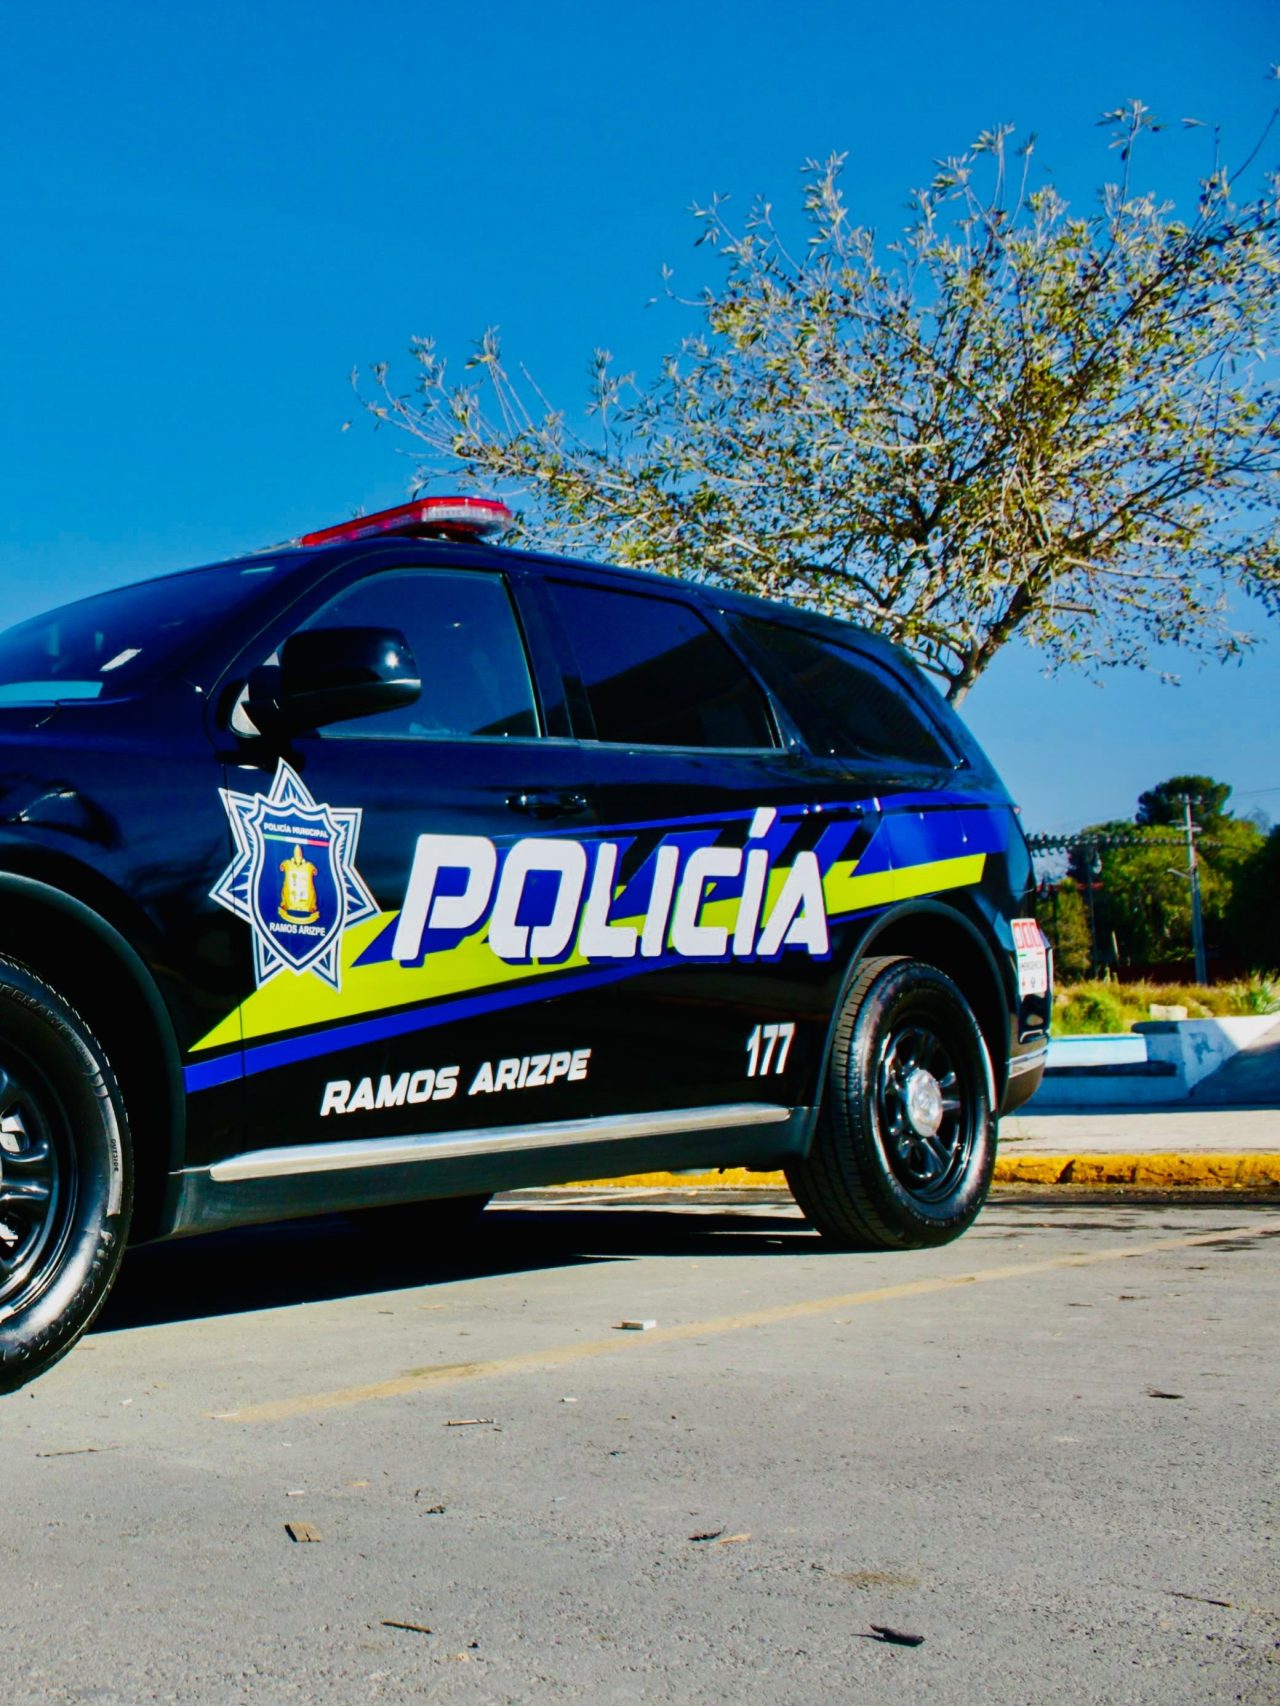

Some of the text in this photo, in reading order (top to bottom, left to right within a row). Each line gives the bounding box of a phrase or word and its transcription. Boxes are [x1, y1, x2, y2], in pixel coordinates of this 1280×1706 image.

[263, 822, 329, 838] POLICÍA MUNICIPAL
[392, 806, 829, 961] POLICÍA
[269, 921, 326, 936] RAMOS ARIZPE
[747, 1023, 795, 1077] 177
[320, 1048, 591, 1117] RAMOS ARIZPE
